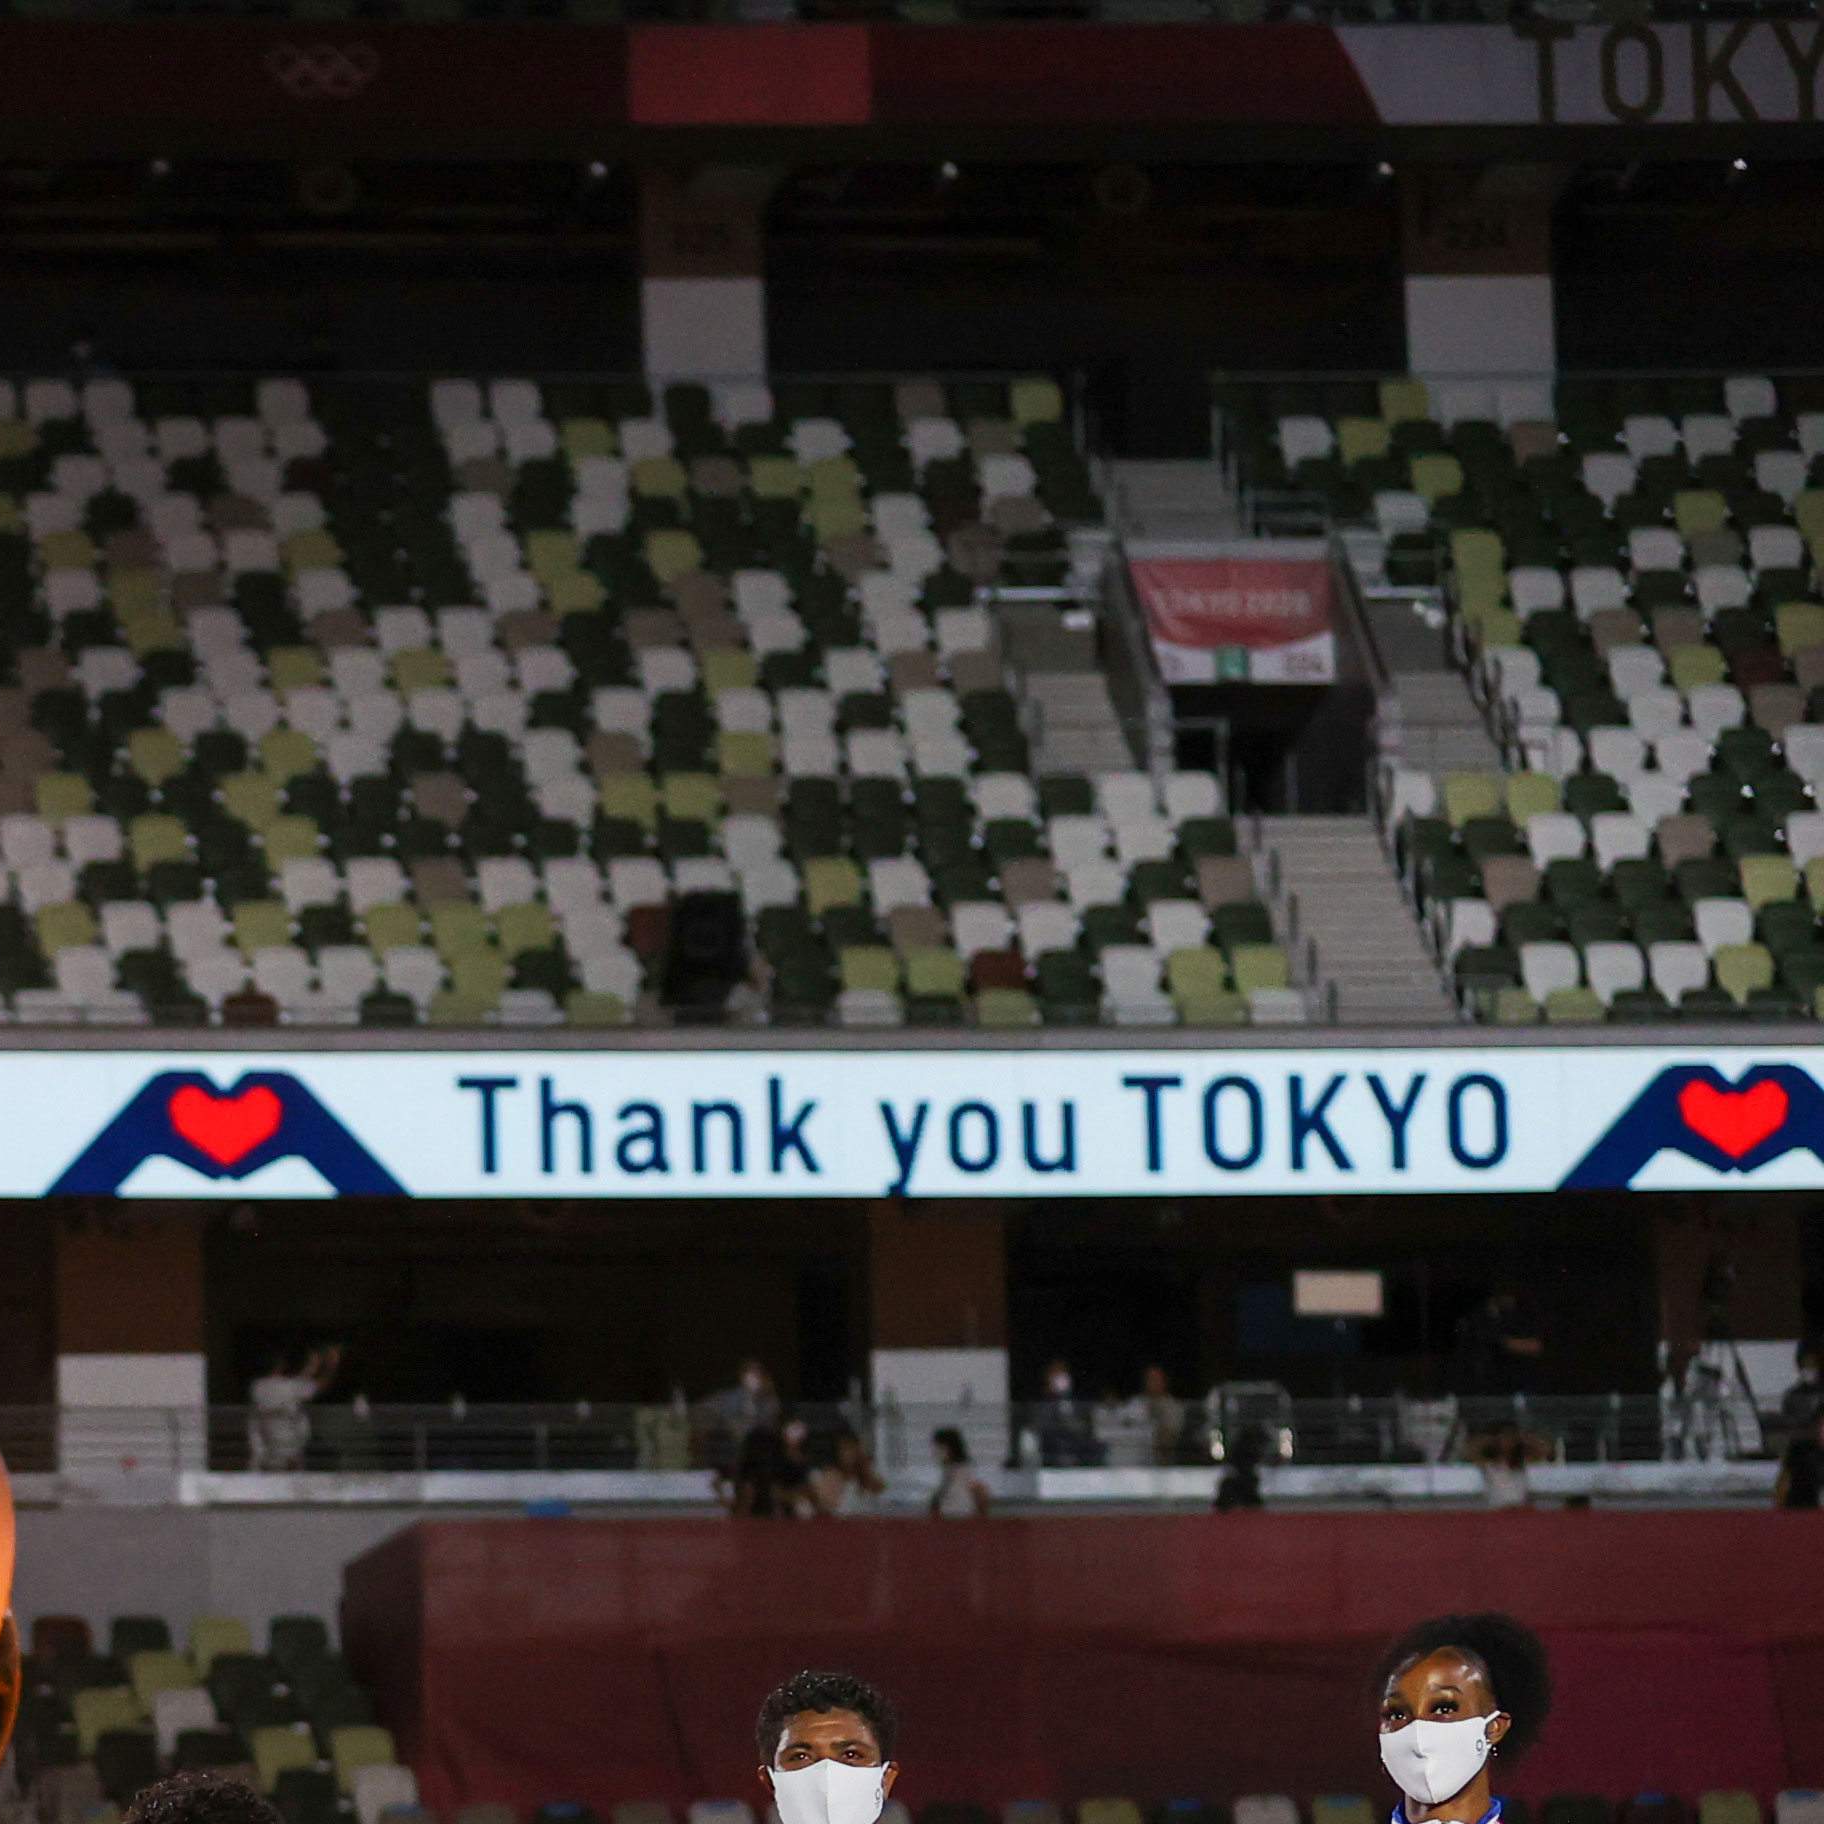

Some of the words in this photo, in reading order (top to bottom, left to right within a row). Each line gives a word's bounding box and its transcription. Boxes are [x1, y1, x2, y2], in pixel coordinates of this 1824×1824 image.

[457, 1077, 821, 1174] Thank
[880, 1101, 1077, 1197] you
[1122, 1073, 1509, 1172] TOKYO
